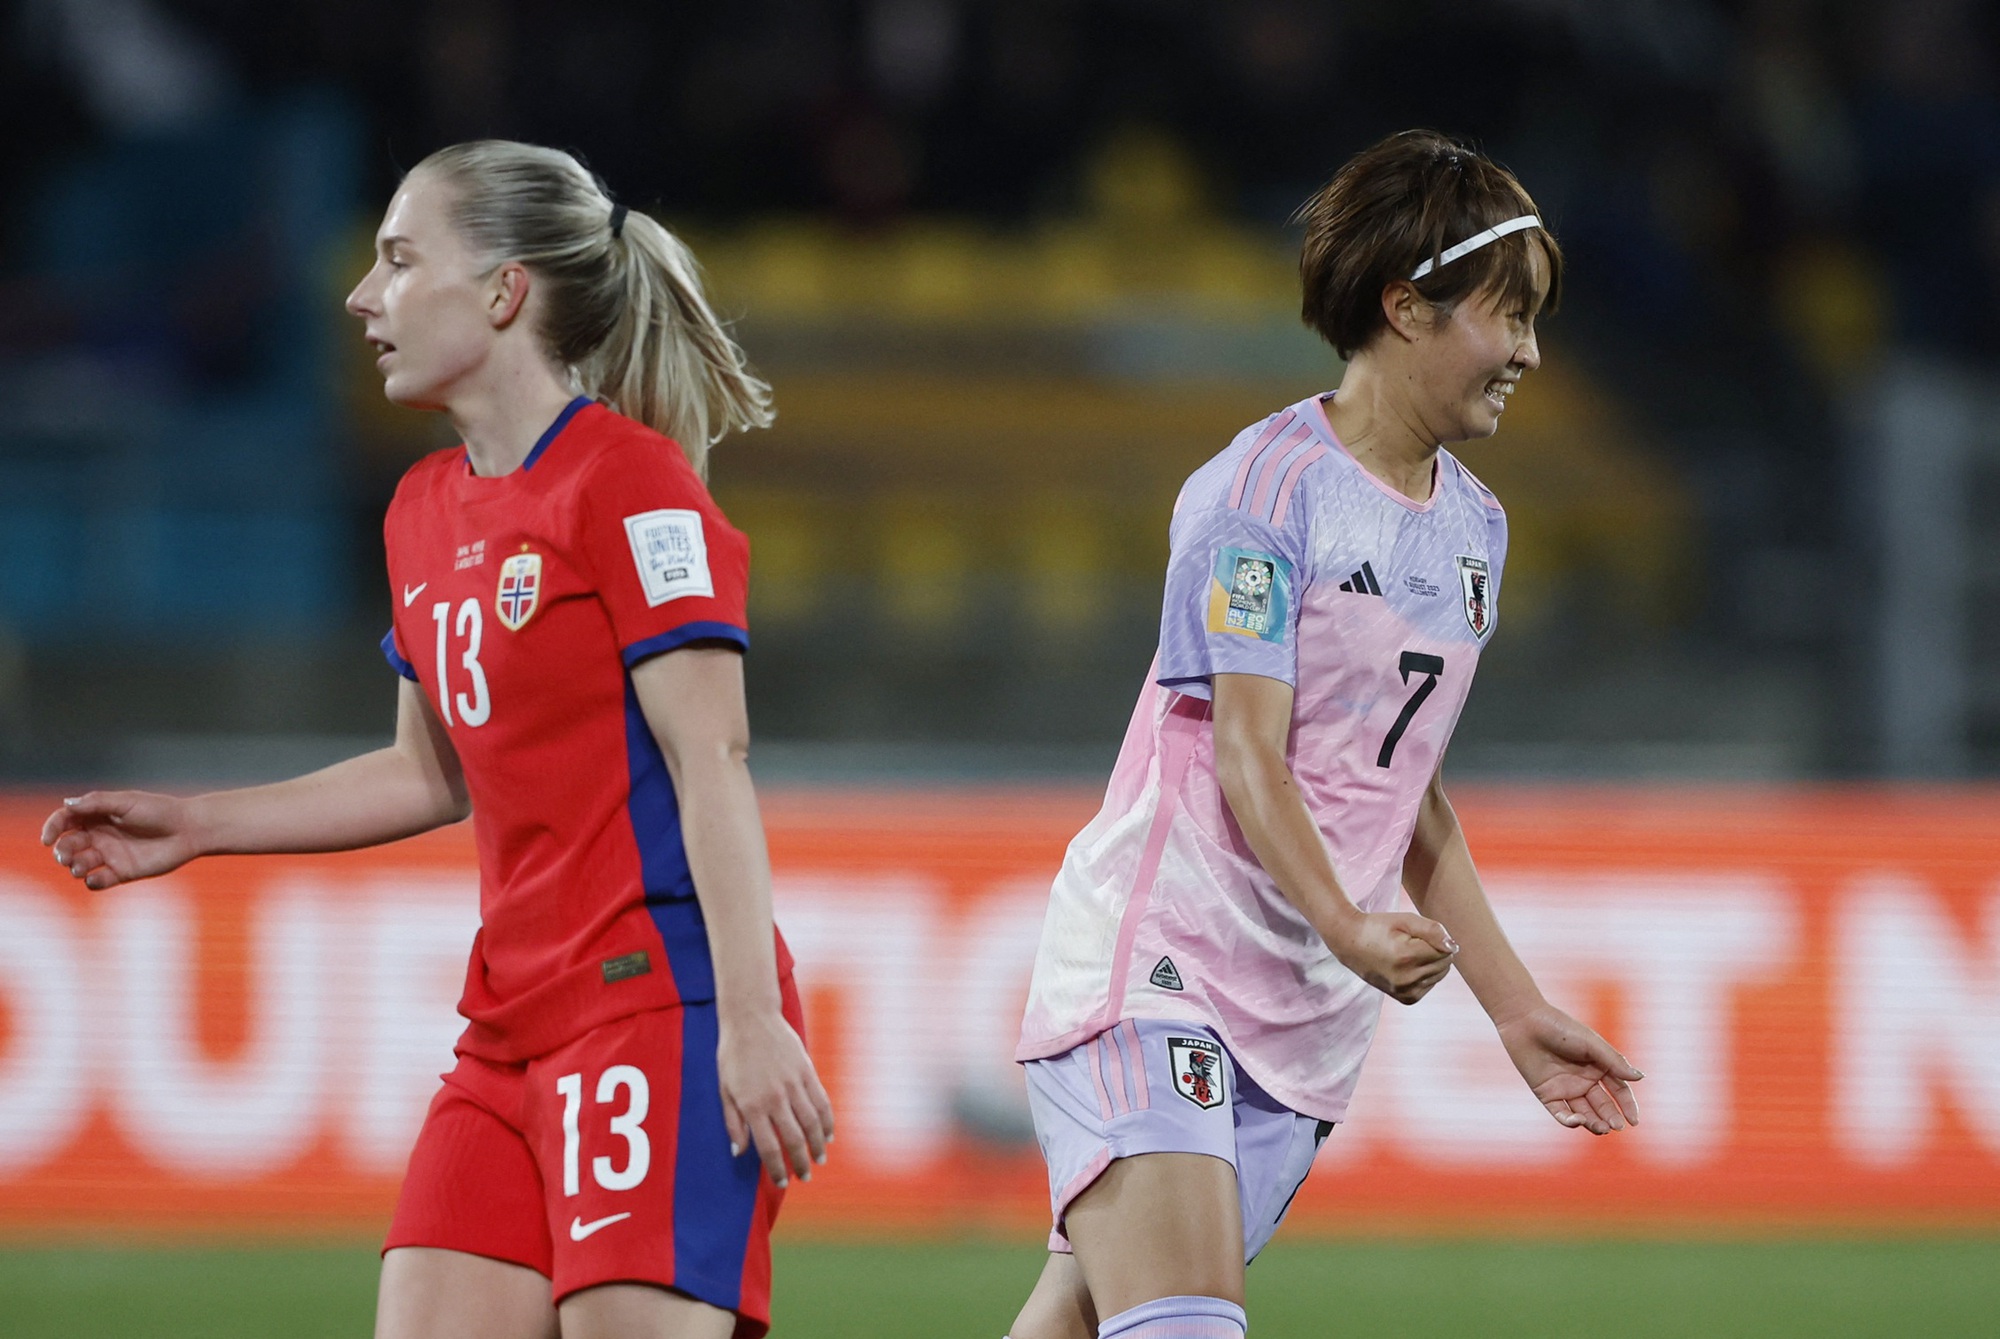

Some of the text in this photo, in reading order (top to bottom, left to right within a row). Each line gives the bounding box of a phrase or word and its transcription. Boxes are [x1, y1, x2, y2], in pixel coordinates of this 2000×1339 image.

[647, 536, 692, 556] UNITES
[1465, 559, 1483, 568] JAPAN
[1409, 582, 1426, 590] AUGUST
[1229, 610, 1245, 618] AU
[432, 598, 491, 727] 13
[1376, 651, 1444, 768] 7
[1181, 1039, 1212, 1050] JAPAN
[557, 1064, 650, 1197] 13
